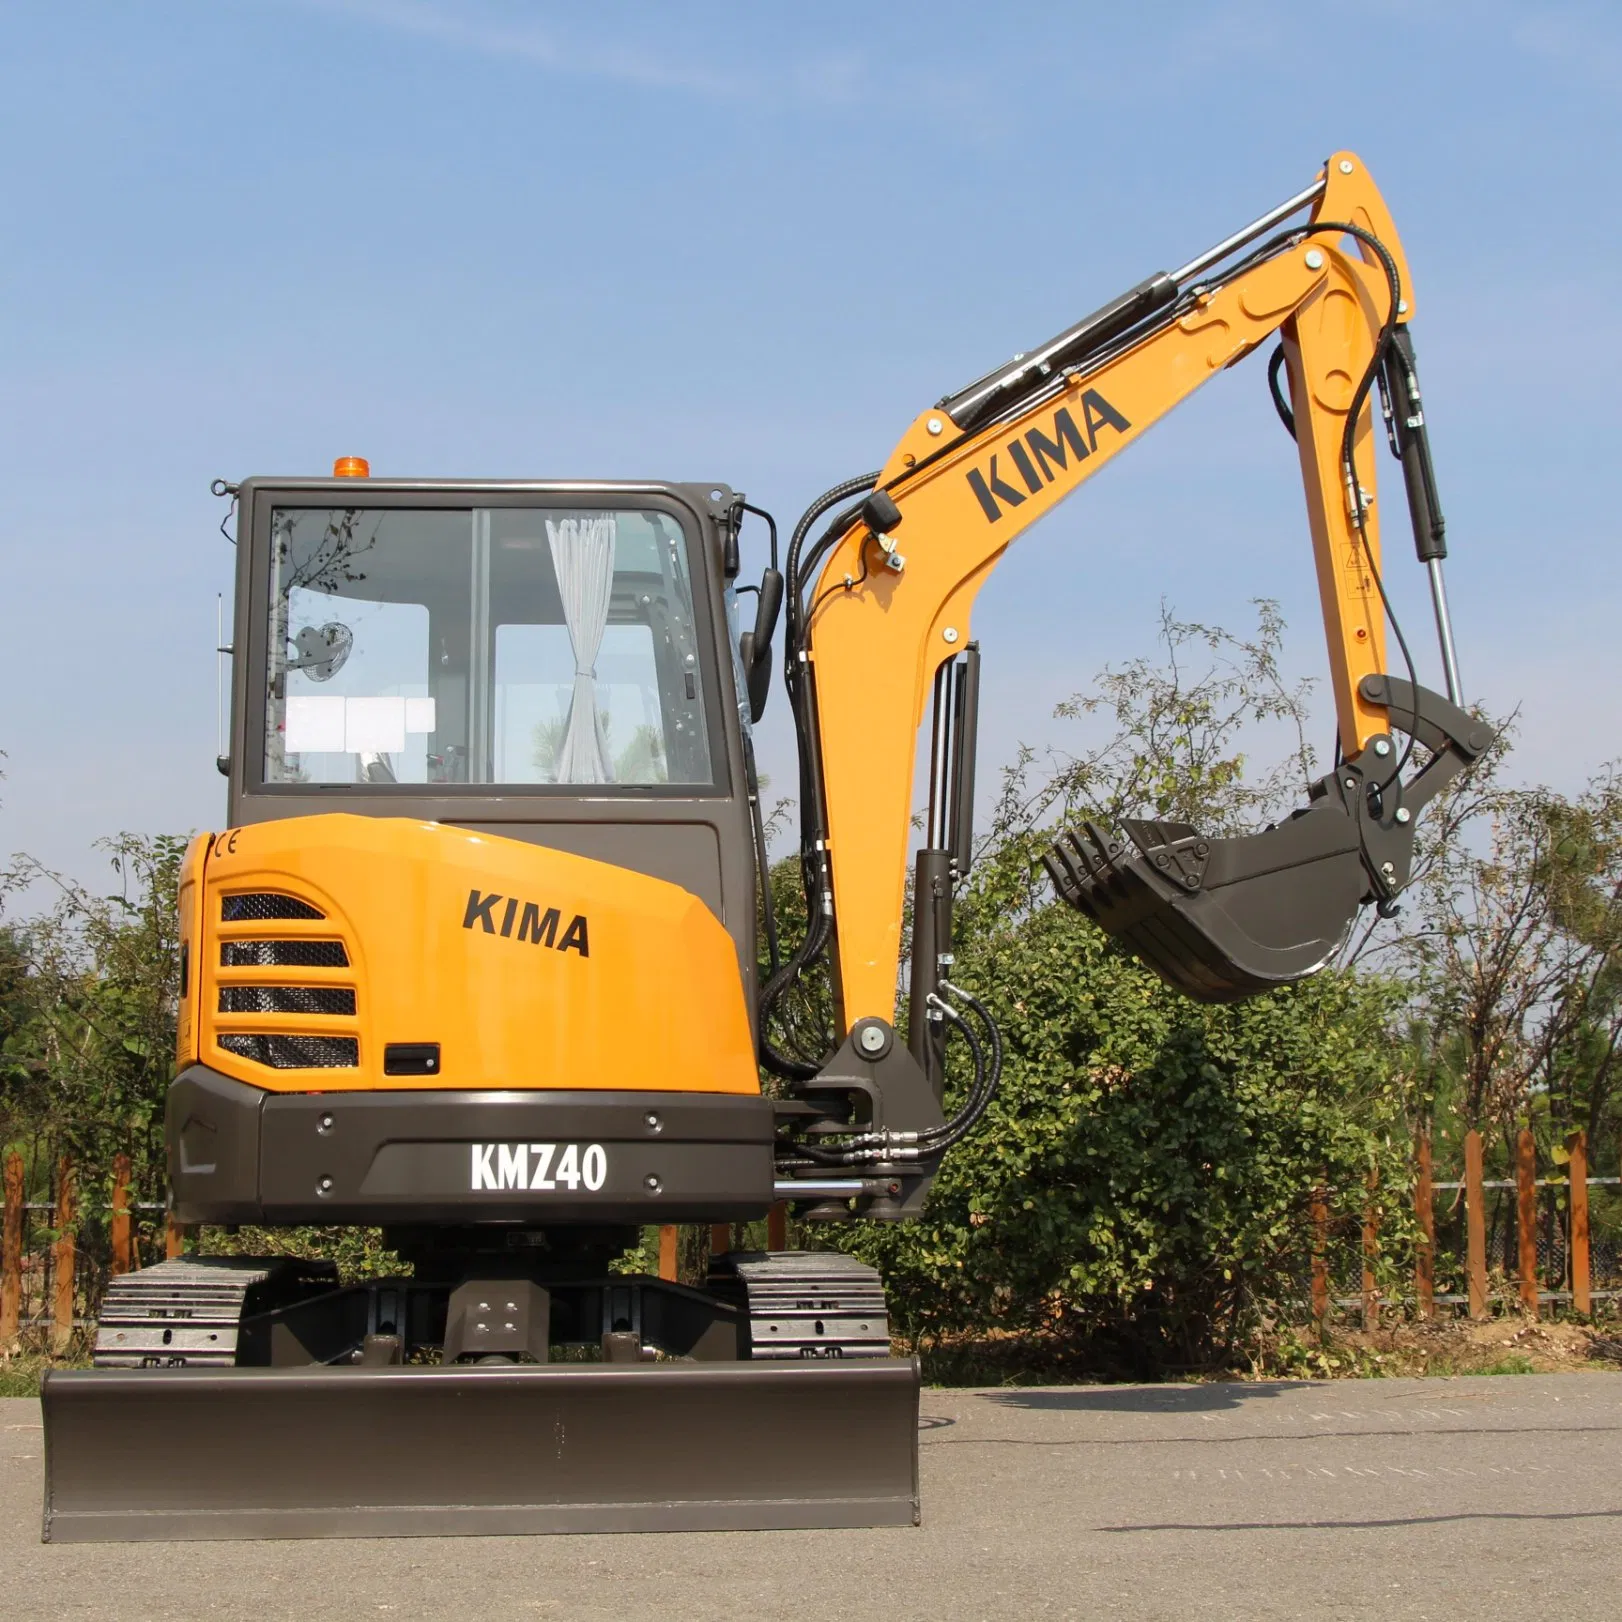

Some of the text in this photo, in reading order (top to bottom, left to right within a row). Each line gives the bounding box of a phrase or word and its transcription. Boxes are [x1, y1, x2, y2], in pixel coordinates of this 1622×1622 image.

[965, 387, 1132, 524] KIMA
[214, 829, 241, 858] CE
[463, 889, 590, 958] KIMA
[470, 1143, 608, 1191] KMZ40
